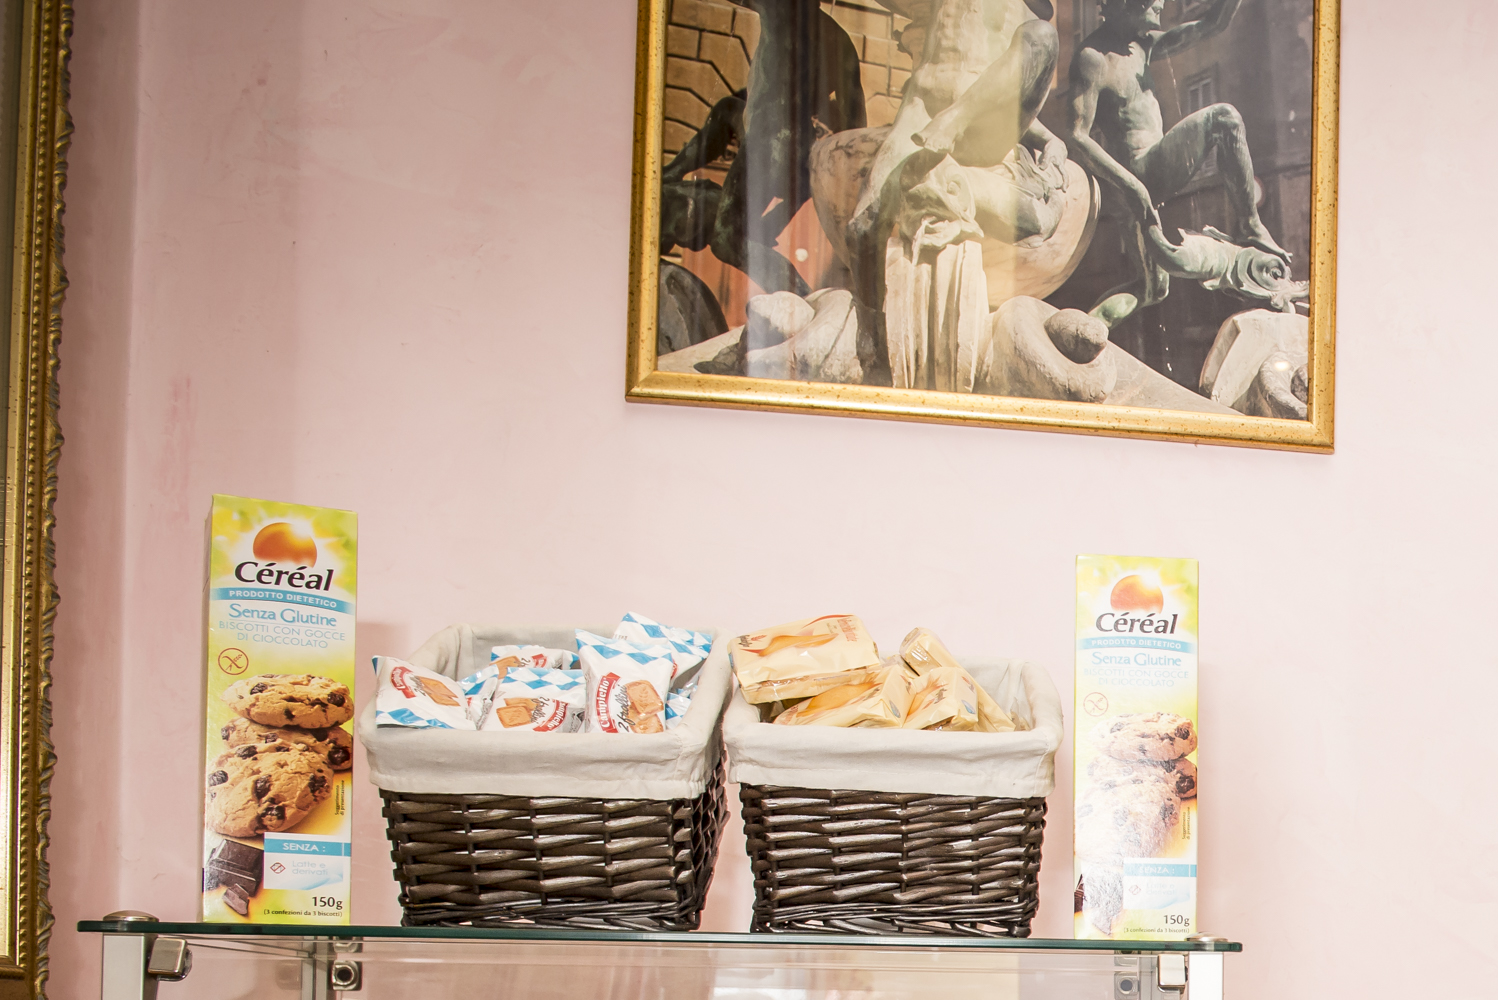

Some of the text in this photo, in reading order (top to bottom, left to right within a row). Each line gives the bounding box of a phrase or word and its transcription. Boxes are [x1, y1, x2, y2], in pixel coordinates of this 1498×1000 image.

[234, 561, 334, 591] Céréal
[229, 590, 337, 608] PRODOTTO DIETETICO
[228, 603, 337, 627] Senza Glutine
[1095, 611, 1178, 635] Céréal
[219, 621, 345, 641] BISCOTTI CON GOCCE
[237, 632, 328, 649] DI CIOCCOLATO
[1138, 639, 1182, 650] DIETETICO
[1091, 651, 1182, 667] Senza Glutine
[1128, 669, 1151, 677] CON
[1154, 670, 1189, 679] GOCCE
[1111, 678, 1174, 688] CIOCCOLATO
[598, 678, 610, 728] Campiello
[618, 721, 630, 732] 2
[282, 842, 319, 852] SENZA
[292, 861, 316, 869] Latte
[292, 868, 328, 876] derivati
[312, 896, 343, 910] 150g
[318, 910, 343, 918] biscotti)
[1163, 914, 1190, 927] 150g
